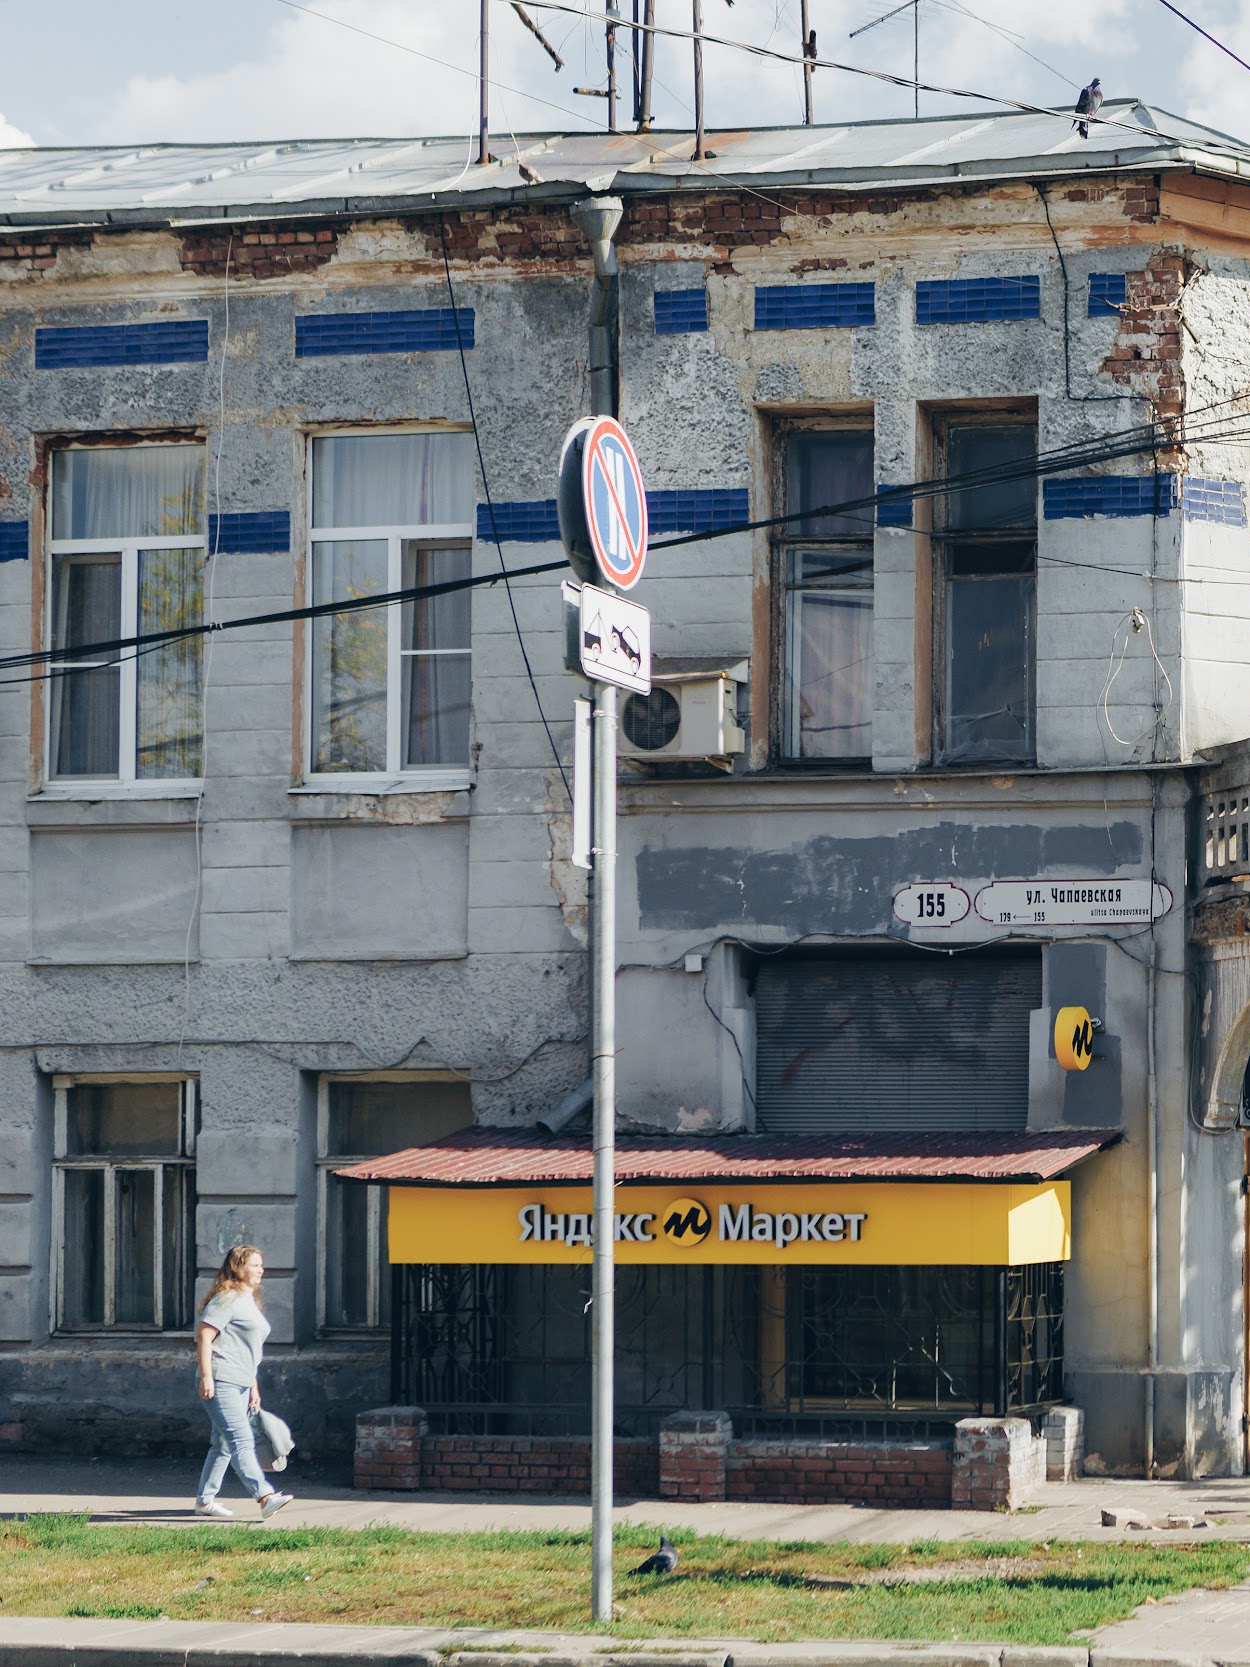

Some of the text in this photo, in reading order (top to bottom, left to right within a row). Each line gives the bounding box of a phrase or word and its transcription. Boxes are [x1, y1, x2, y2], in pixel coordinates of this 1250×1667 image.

[917, 893, 945, 917] 155
[1026, 888, 1122, 905] ул. Чапаевская
[1000, 911, 1046, 922] 179 155
[518, 1204, 656, 1247] Яндкс
[718, 1203, 868, 1248] Маркет
